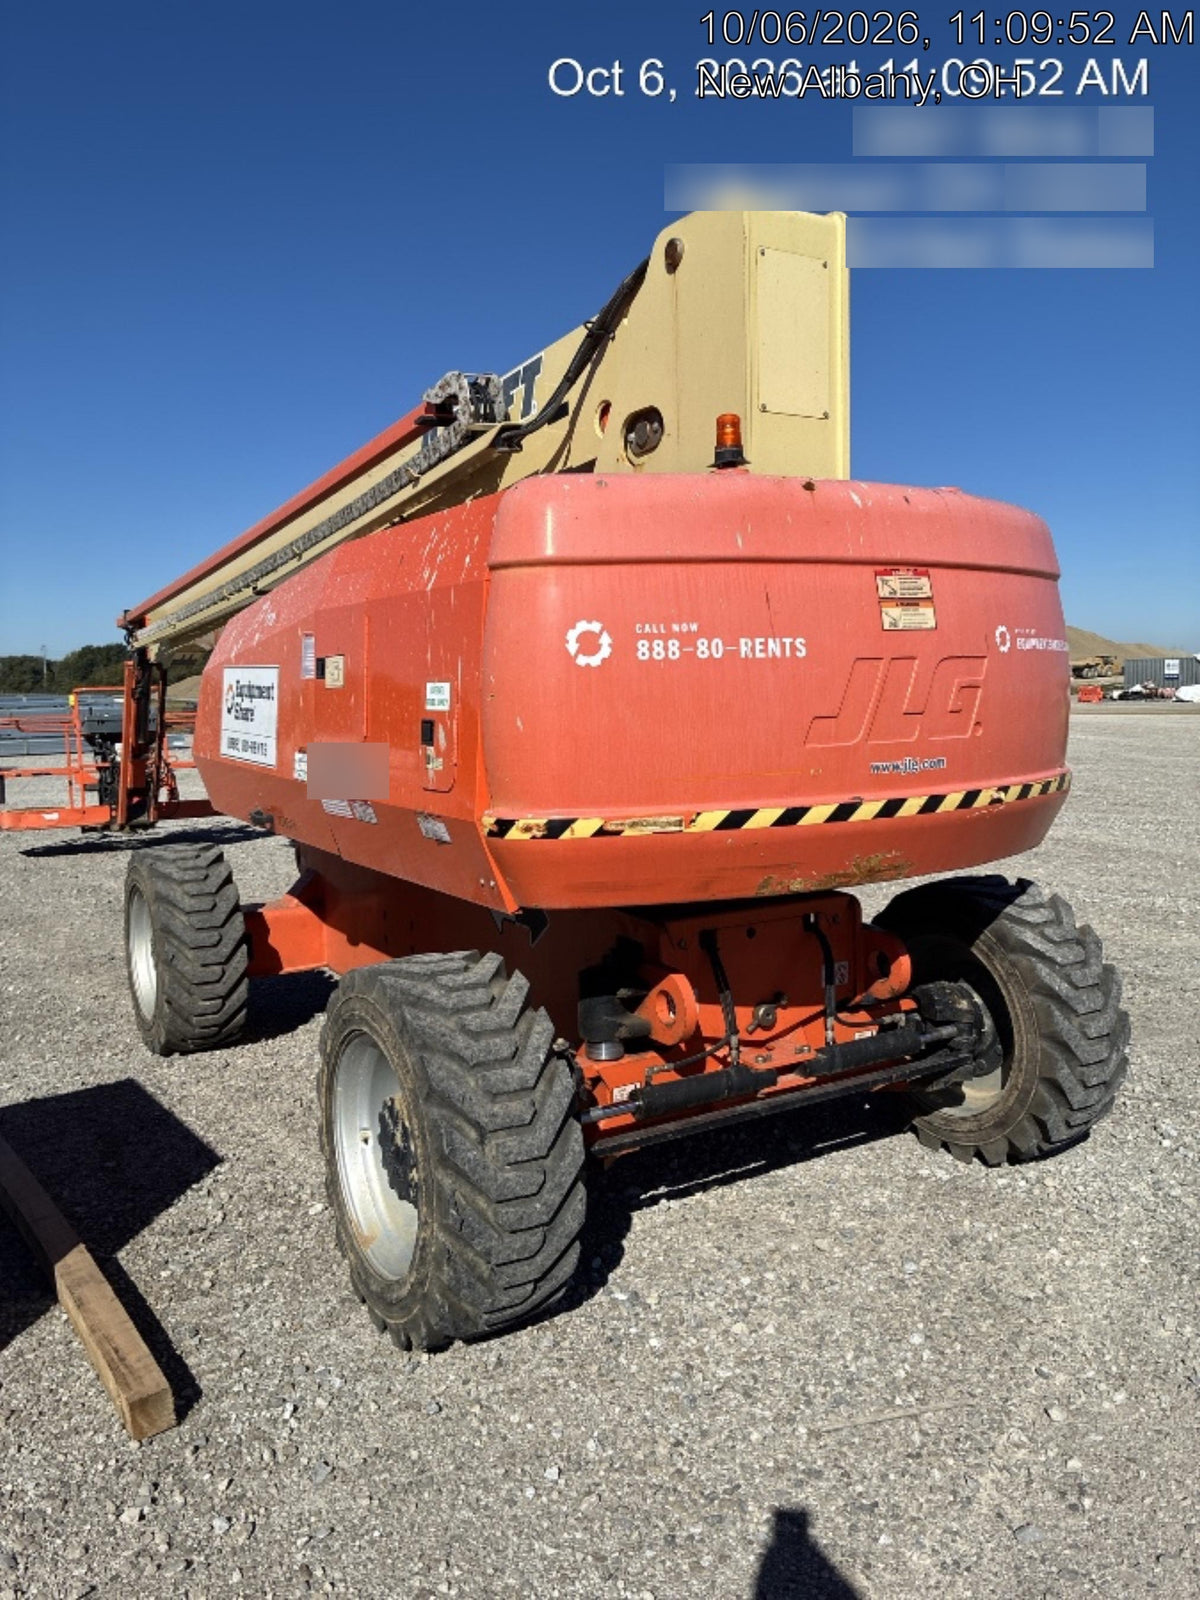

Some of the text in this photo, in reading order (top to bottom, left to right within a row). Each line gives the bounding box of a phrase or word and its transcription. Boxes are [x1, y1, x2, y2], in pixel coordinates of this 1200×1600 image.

[635, 622, 699, 634] CALL NOW
[636, 637, 807, 661] 888-80-RENTS
[235, 680, 275, 703] Equipment
[804, 655, 988, 748] JLG
[234, 702, 255, 722] Share
[869, 757, 947, 775] www.jlg.com
